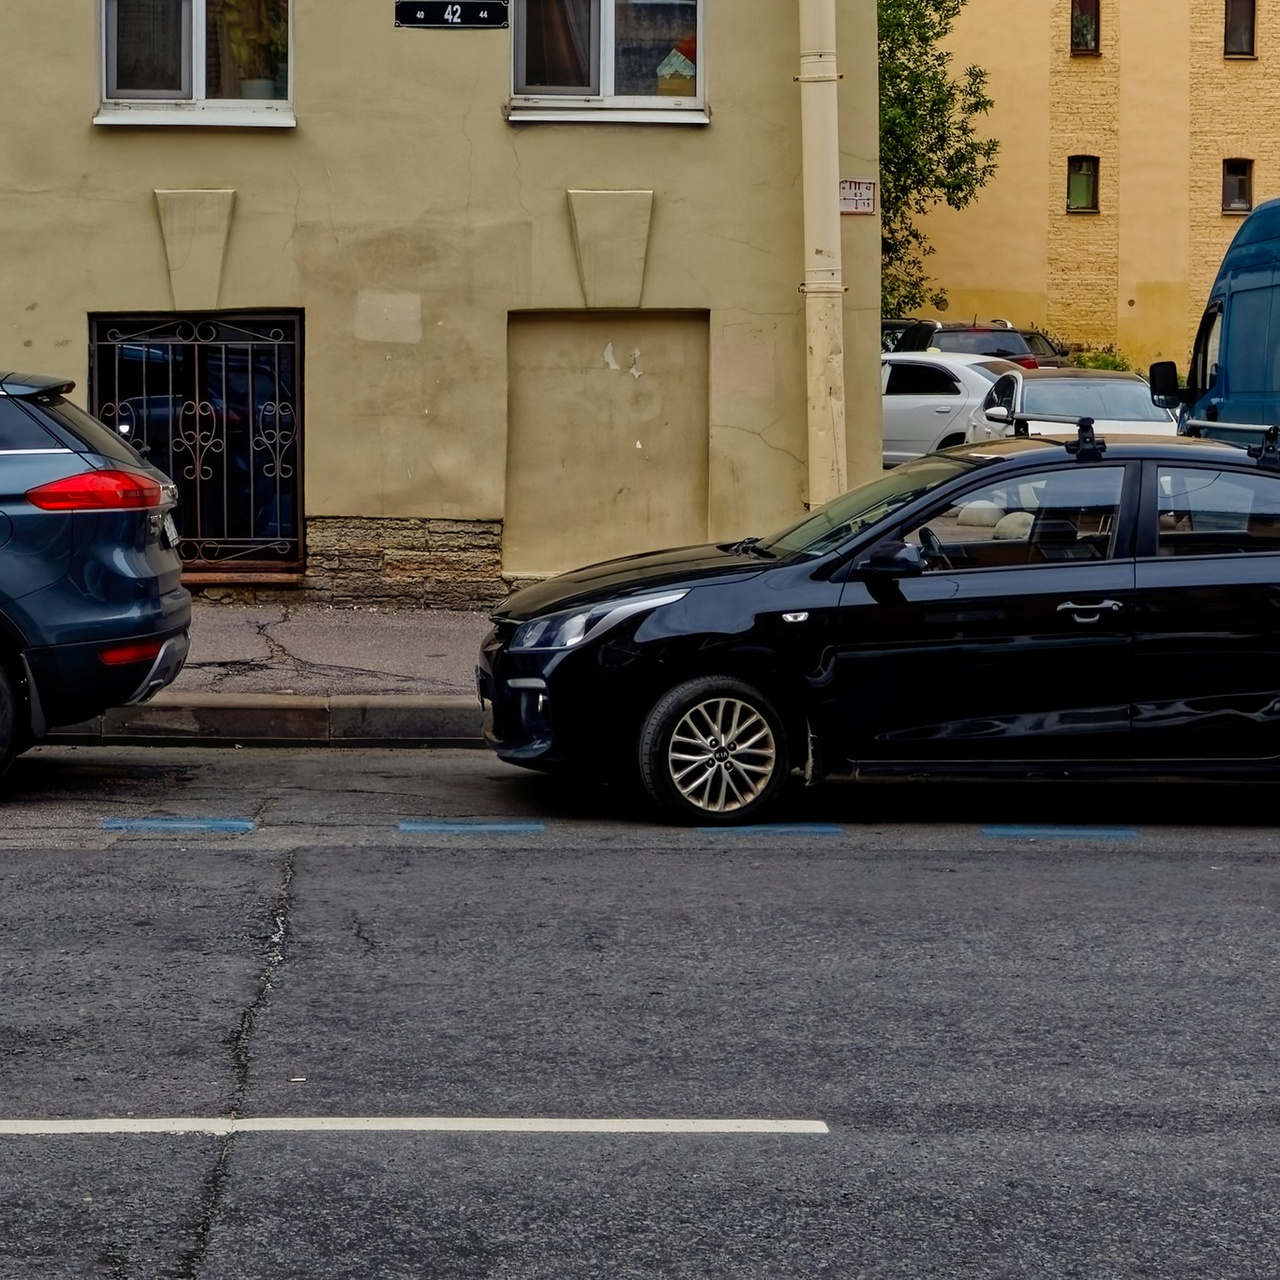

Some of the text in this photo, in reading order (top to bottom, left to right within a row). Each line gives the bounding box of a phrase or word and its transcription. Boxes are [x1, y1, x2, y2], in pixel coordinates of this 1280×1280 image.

[416, 4, 488, 23] 40 42 44
